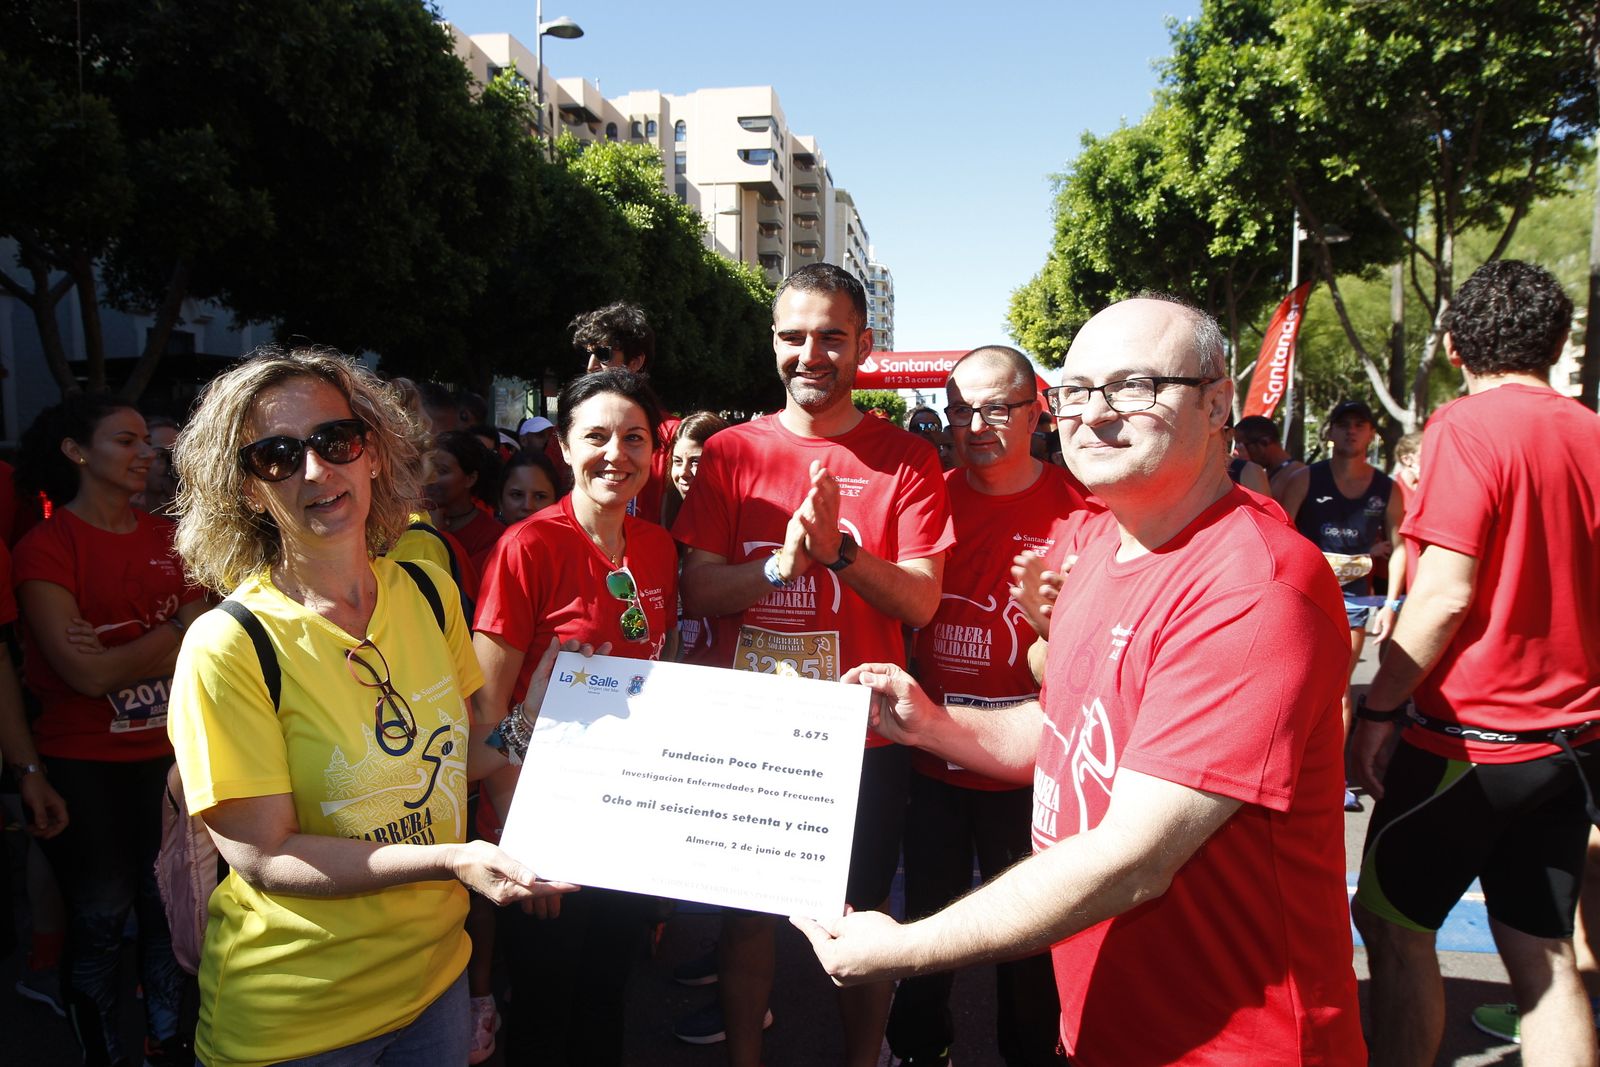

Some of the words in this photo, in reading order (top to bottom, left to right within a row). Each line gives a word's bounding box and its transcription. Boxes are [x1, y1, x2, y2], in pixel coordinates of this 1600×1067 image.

[835, 475, 869, 485] Santander
[1022, 535, 1056, 545] Santander
[934, 623, 992, 645] CARRERA
[933, 638, 991, 660] SOLIDARIA
[559, 672, 573, 683] La
[589, 675, 619, 688] Salle
[793, 728, 829, 741] 8.675
[661, 749, 725, 765] Fundacion
[729, 757, 757, 770] Poco
[762, 762, 824, 779] Frecuente
[622, 769, 684, 782] Investigacion
[687, 777, 754, 794] Enfermedades
[757, 787, 780, 797] Poco
[783, 790, 835, 804] Frecuentes
[602, 794, 632, 807] Ocho
[636, 799, 657, 810] mil
[660, 803, 728, 820] seiscientos
[732, 814, 781, 828] setenta
[785, 821, 793, 831] y
[797, 821, 829, 834] cinco
[349, 807, 432, 845] RRERA
[731, 842, 738, 850] 2
[740, 843, 753, 852] de
[755, 844, 781, 855] junio
[784, 849, 797, 858] de
[800, 851, 826, 862] 2019
